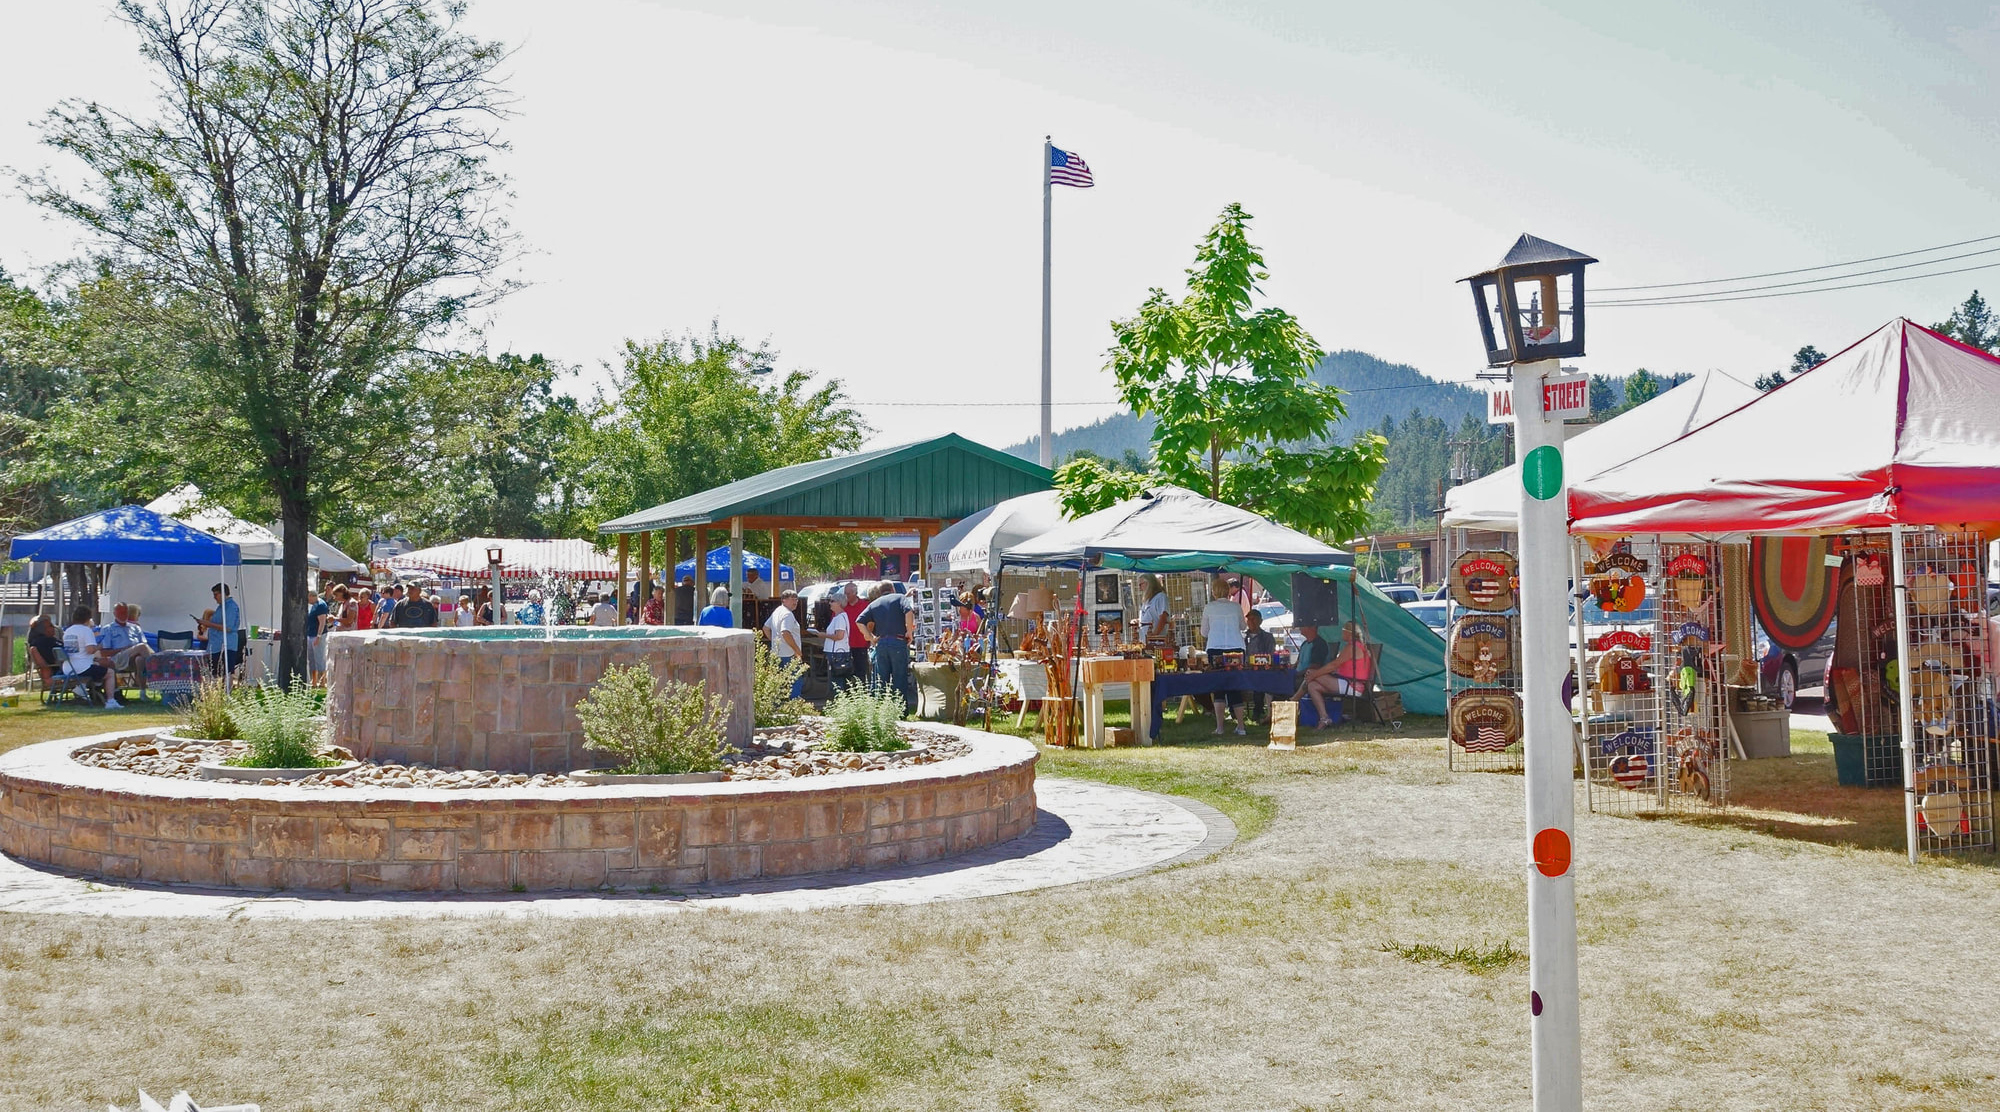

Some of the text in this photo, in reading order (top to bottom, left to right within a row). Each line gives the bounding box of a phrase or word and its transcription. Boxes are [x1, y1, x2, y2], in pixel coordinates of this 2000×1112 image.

[1544, 380, 1586, 412] STREET
[1463, 562, 1502, 575] WELCOME
[1597, 557, 1644, 572] WELCOME
[1669, 559, 1702, 574] WELCOME
[1463, 624, 1503, 637] WELCOME
[1672, 625, 1706, 643] WELCOME
[1873, 621, 1895, 637] WELC
[1602, 634, 1647, 650] WELCOME
[1464, 708, 1505, 722] WELCOME
[1605, 736, 1651, 753] WELCOME
[1675, 737, 1710, 757] WELCOME
